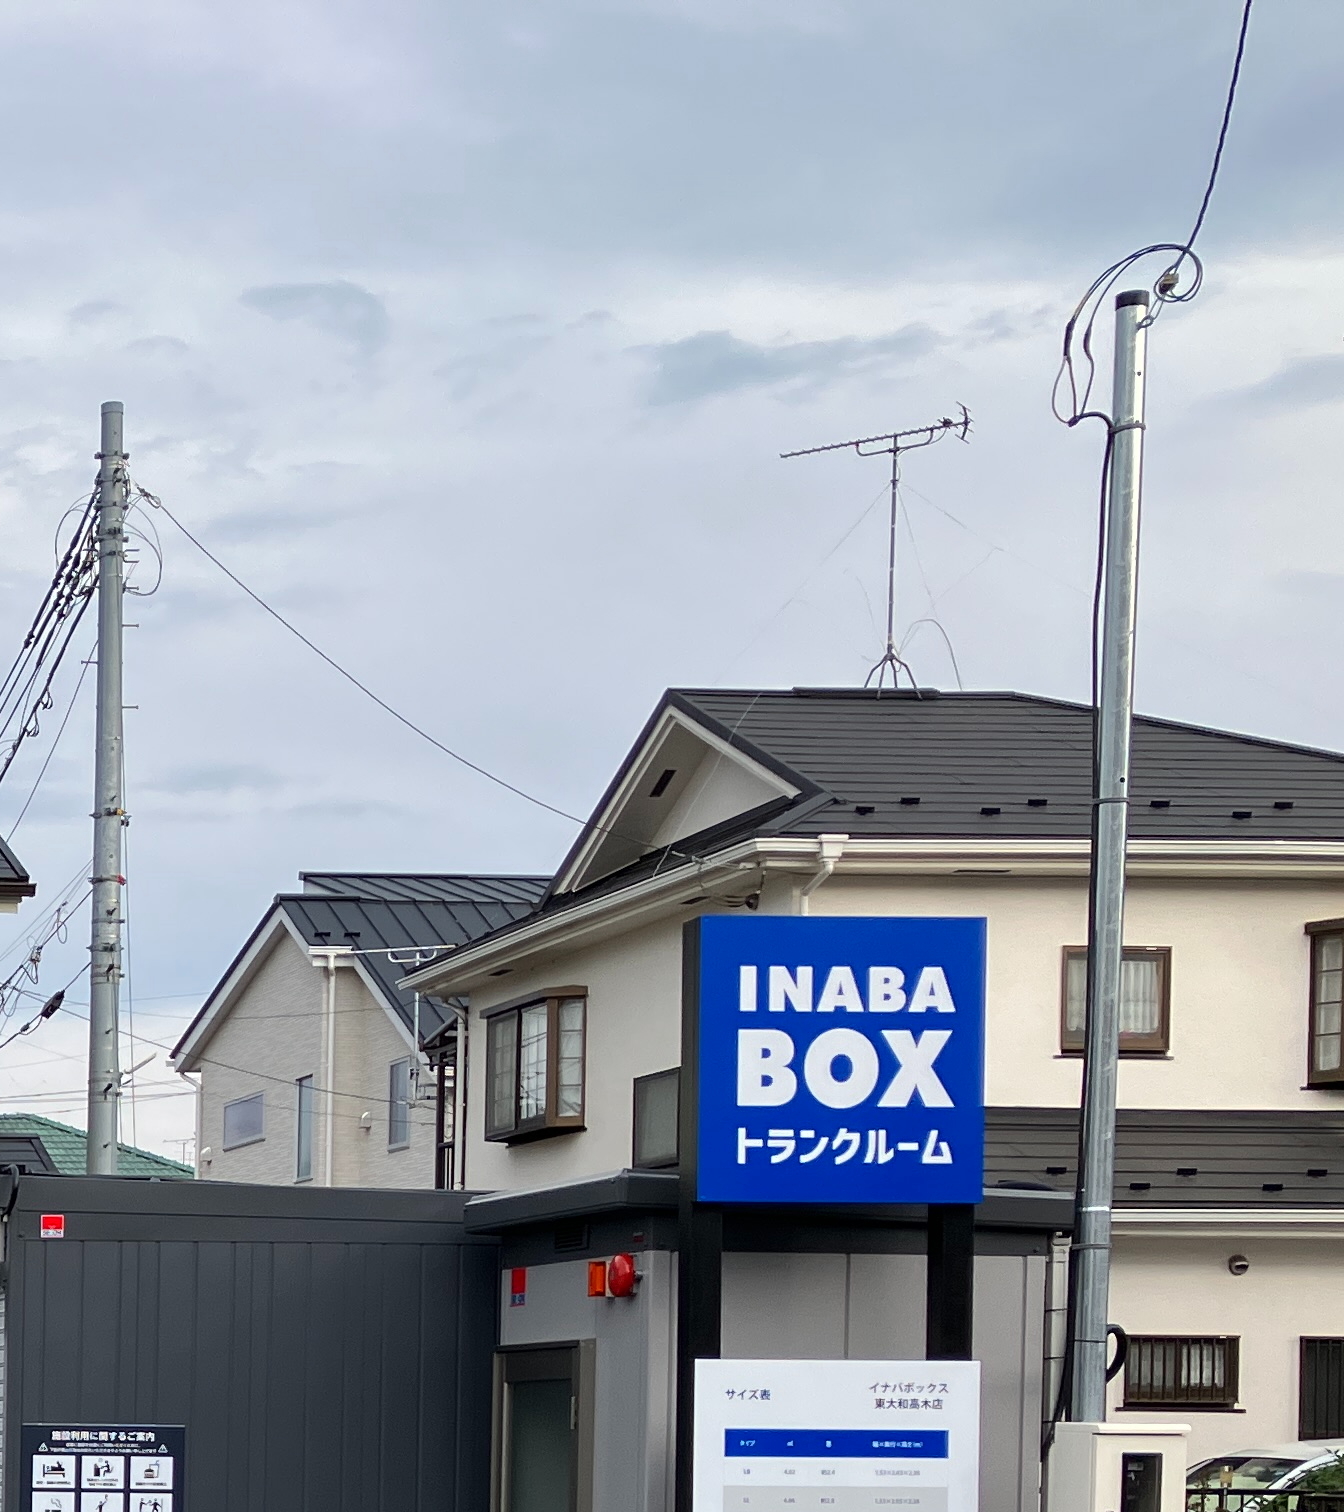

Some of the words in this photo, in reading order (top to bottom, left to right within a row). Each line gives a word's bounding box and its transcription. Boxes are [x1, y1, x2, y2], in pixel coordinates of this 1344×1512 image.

[739, 965, 956, 1013] INABA
[737, 1027, 955, 1109] BOX
[737, 1127, 953, 1165] トランクルーム
[725, 1389, 771, 1400] サイズ表
[869, 1382, 949, 1393] イナバボックス
[875, 1398, 943, 1409] 東大和高木店
